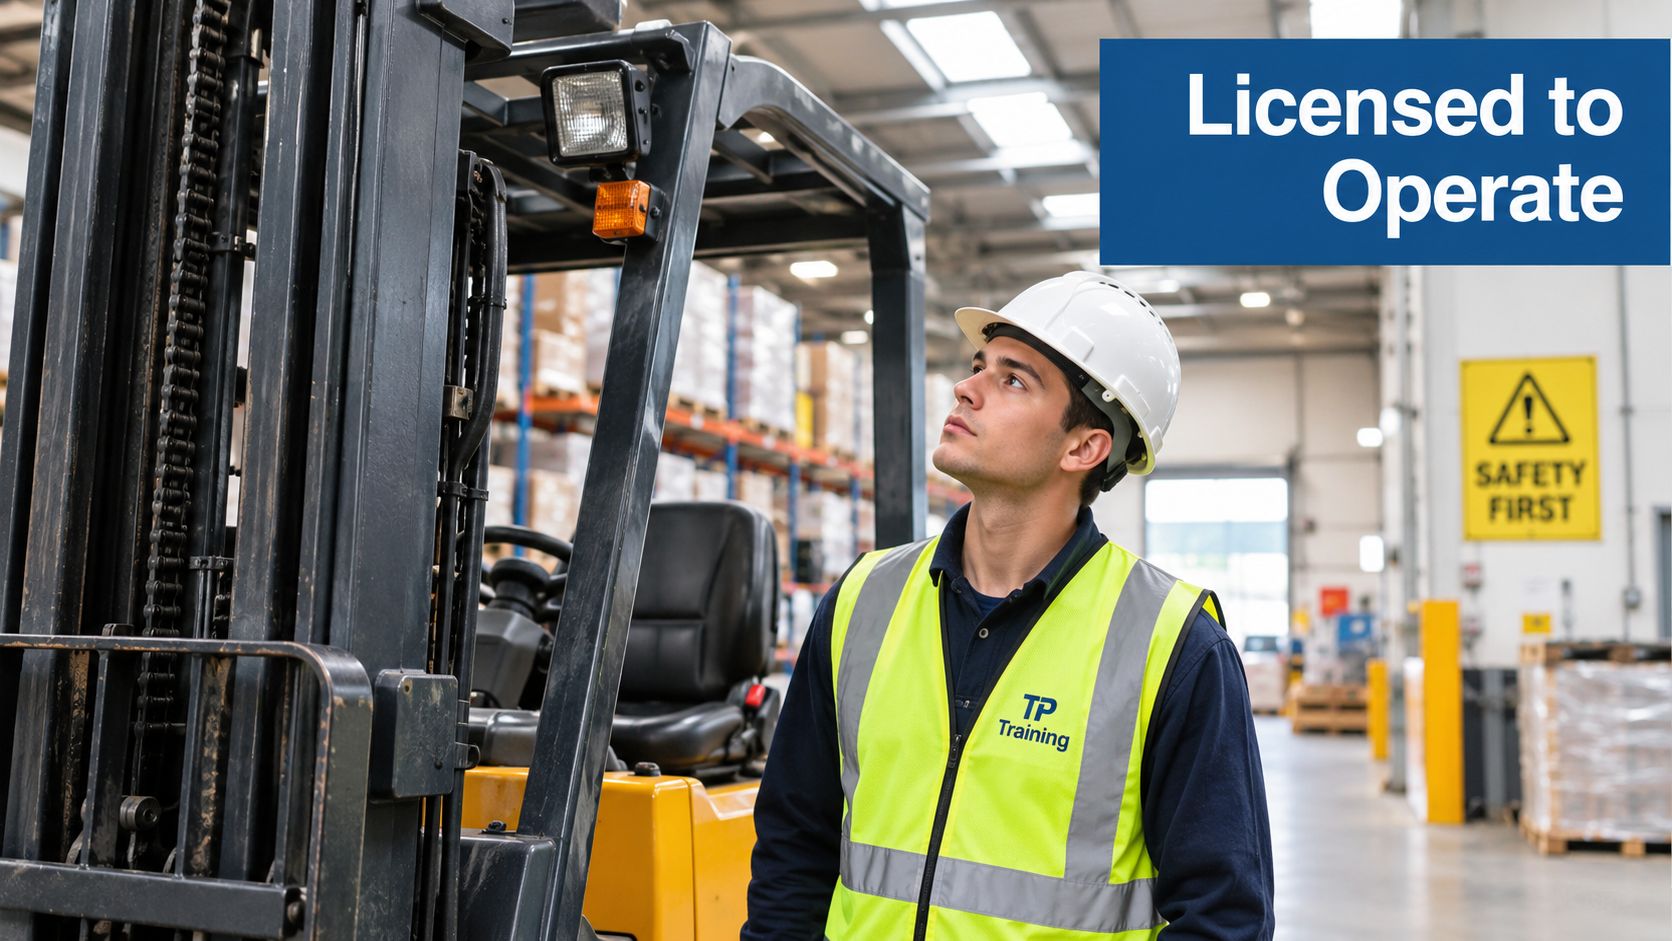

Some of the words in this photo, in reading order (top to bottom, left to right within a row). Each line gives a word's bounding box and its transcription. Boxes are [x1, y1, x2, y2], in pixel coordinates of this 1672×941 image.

[1475, 459, 1587, 488] SAFETY
[1488, 494, 1572, 522] FIRST
[1023, 693, 1057, 722] TP
[999, 719, 1070, 752] Training
